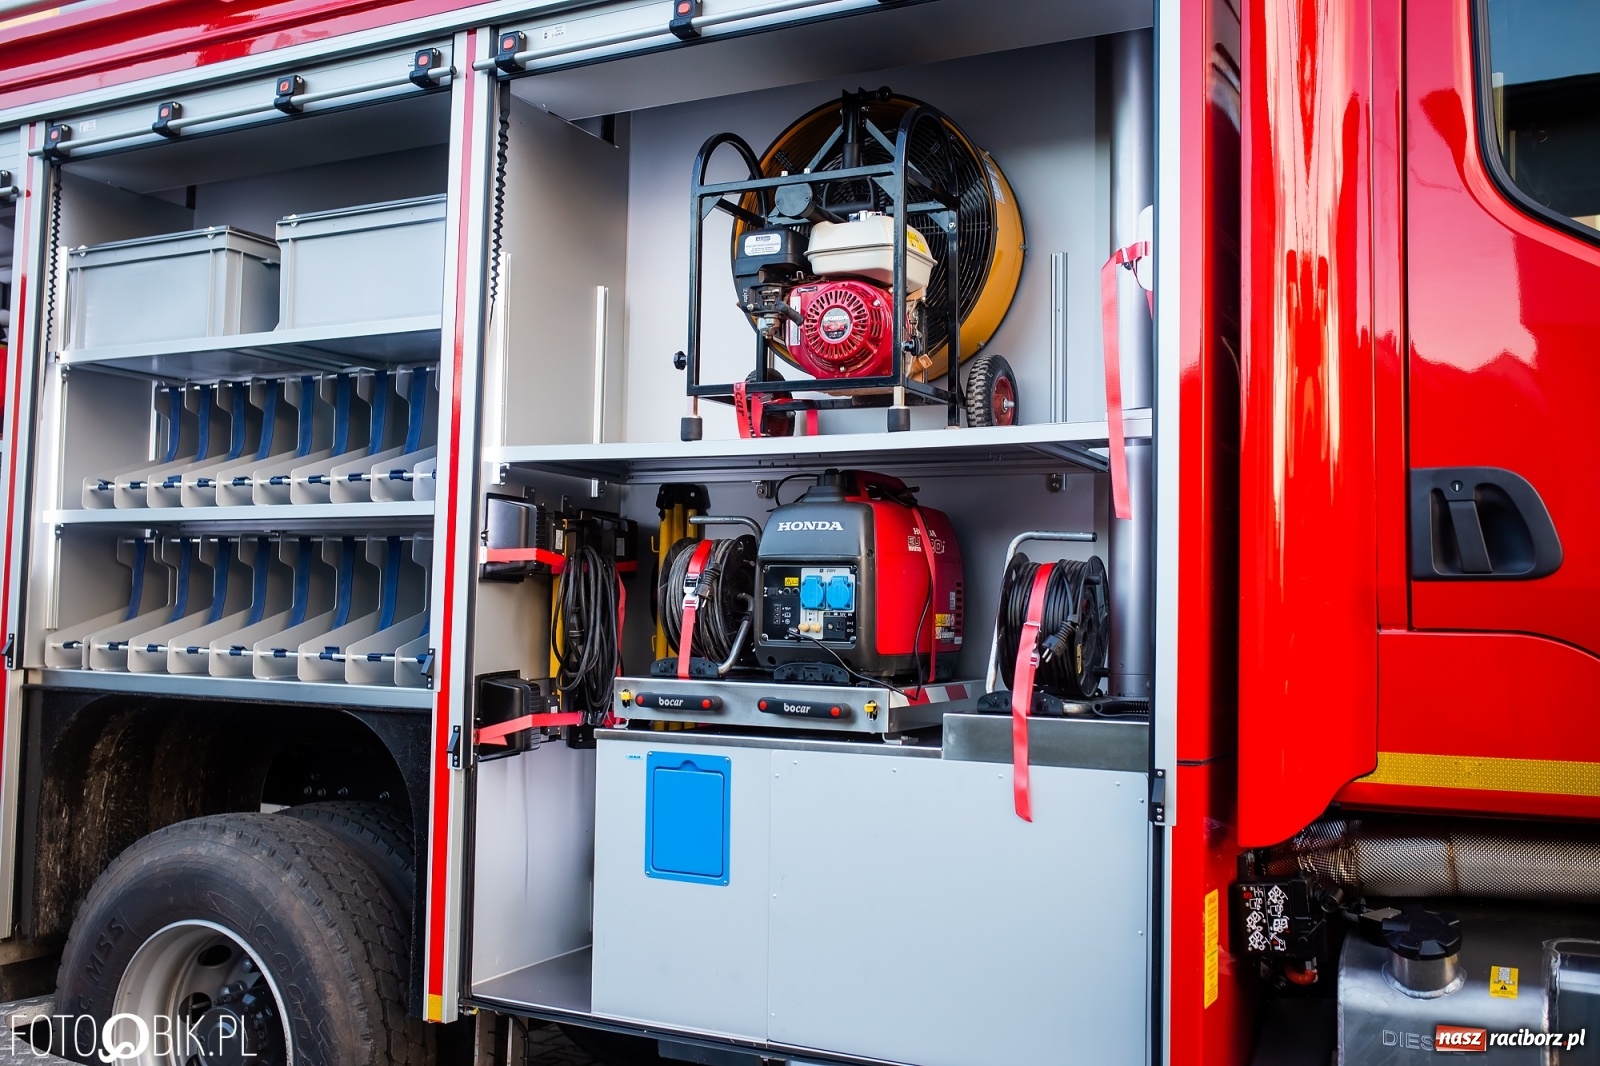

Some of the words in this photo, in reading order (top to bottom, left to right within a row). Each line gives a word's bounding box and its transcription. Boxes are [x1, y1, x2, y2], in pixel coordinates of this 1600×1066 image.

[777, 521, 844, 531] HONDA
[658, 696, 684, 707] bocar
[783, 702, 811, 714] bocar
